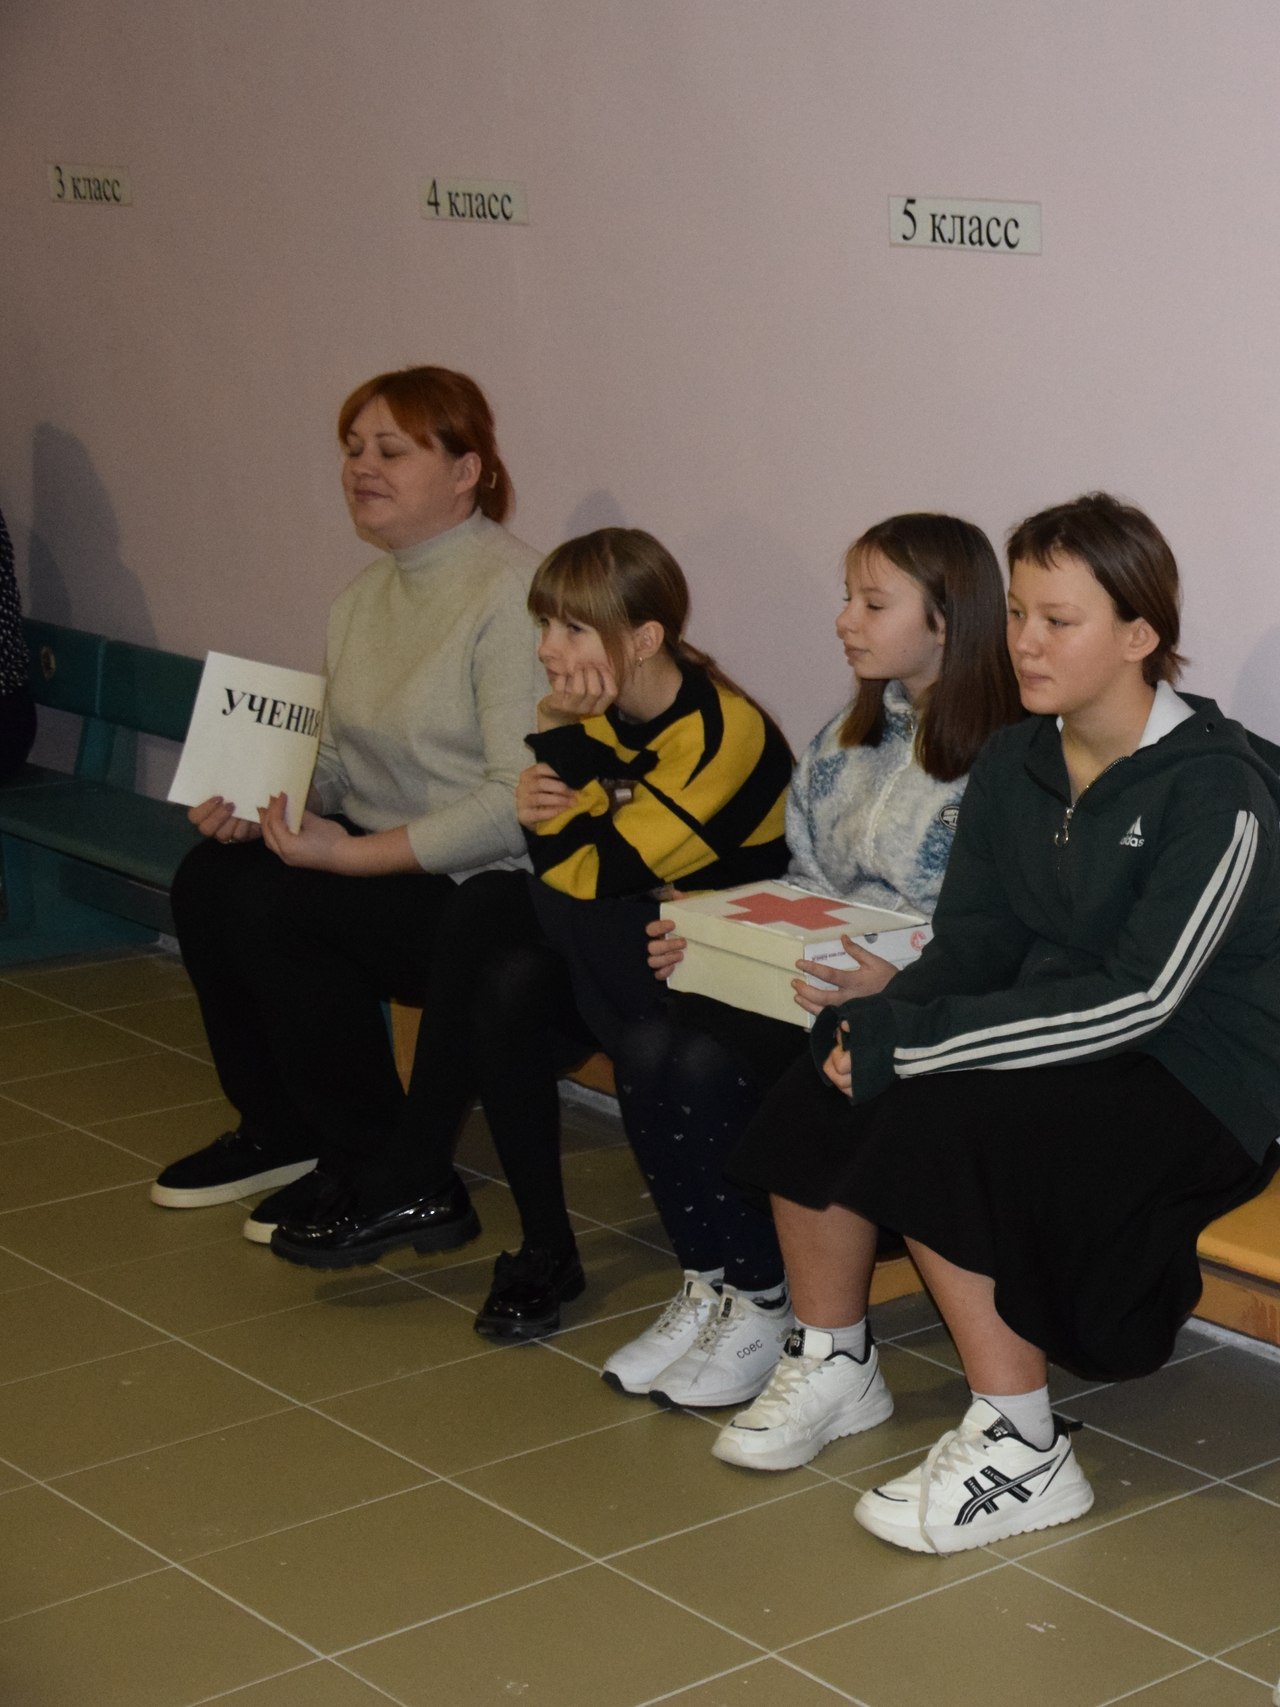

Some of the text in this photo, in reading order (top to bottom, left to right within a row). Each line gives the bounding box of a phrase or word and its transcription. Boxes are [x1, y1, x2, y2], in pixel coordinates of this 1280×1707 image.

[54, 165, 121, 202] 3 класс
[427, 178, 512, 221] 4 класс
[902, 198, 1020, 249] 5 класс
